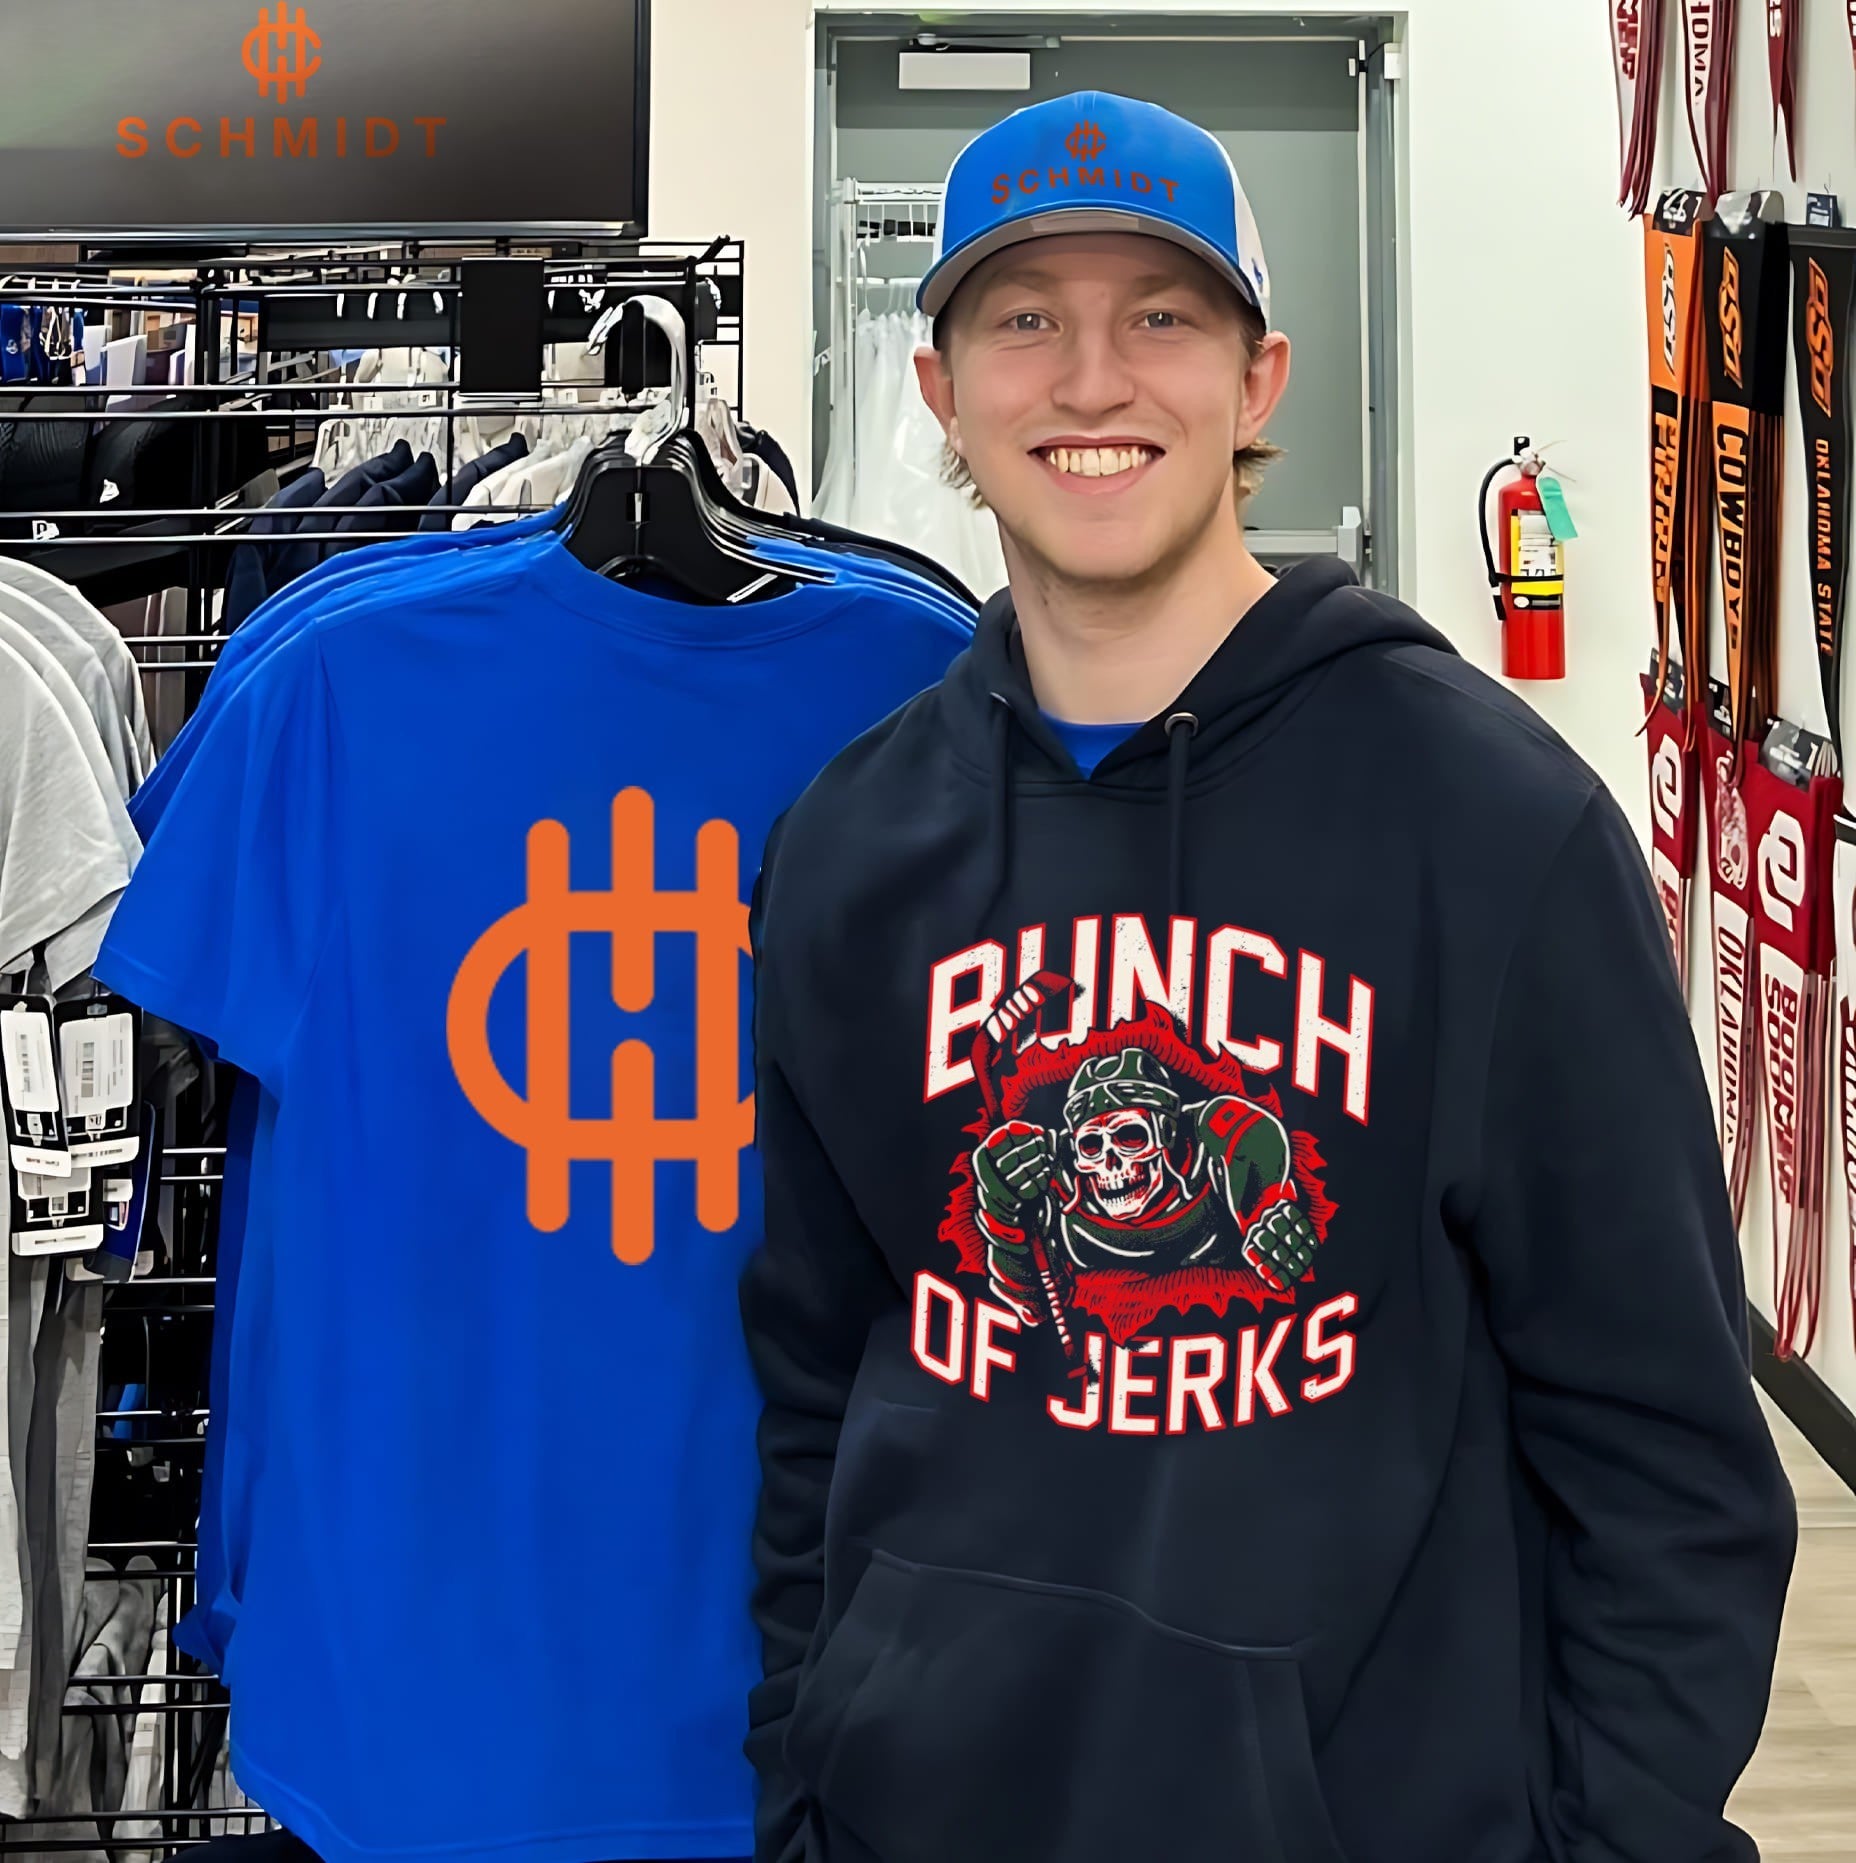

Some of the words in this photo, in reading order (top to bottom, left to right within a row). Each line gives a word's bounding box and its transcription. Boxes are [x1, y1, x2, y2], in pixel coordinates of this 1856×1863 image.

[115, 116, 447, 158] SCHMIDT
[991, 166, 1180, 205] SCHMIDT
[1815, 438, 1832, 570] OKLAHOMA
[923, 912, 1376, 1127] BUNCH
[1718, 926, 1745, 1144] OKLAHOMA
[911, 1268, 1023, 1402] OF
[1045, 1291, 1360, 1435] JERKS
